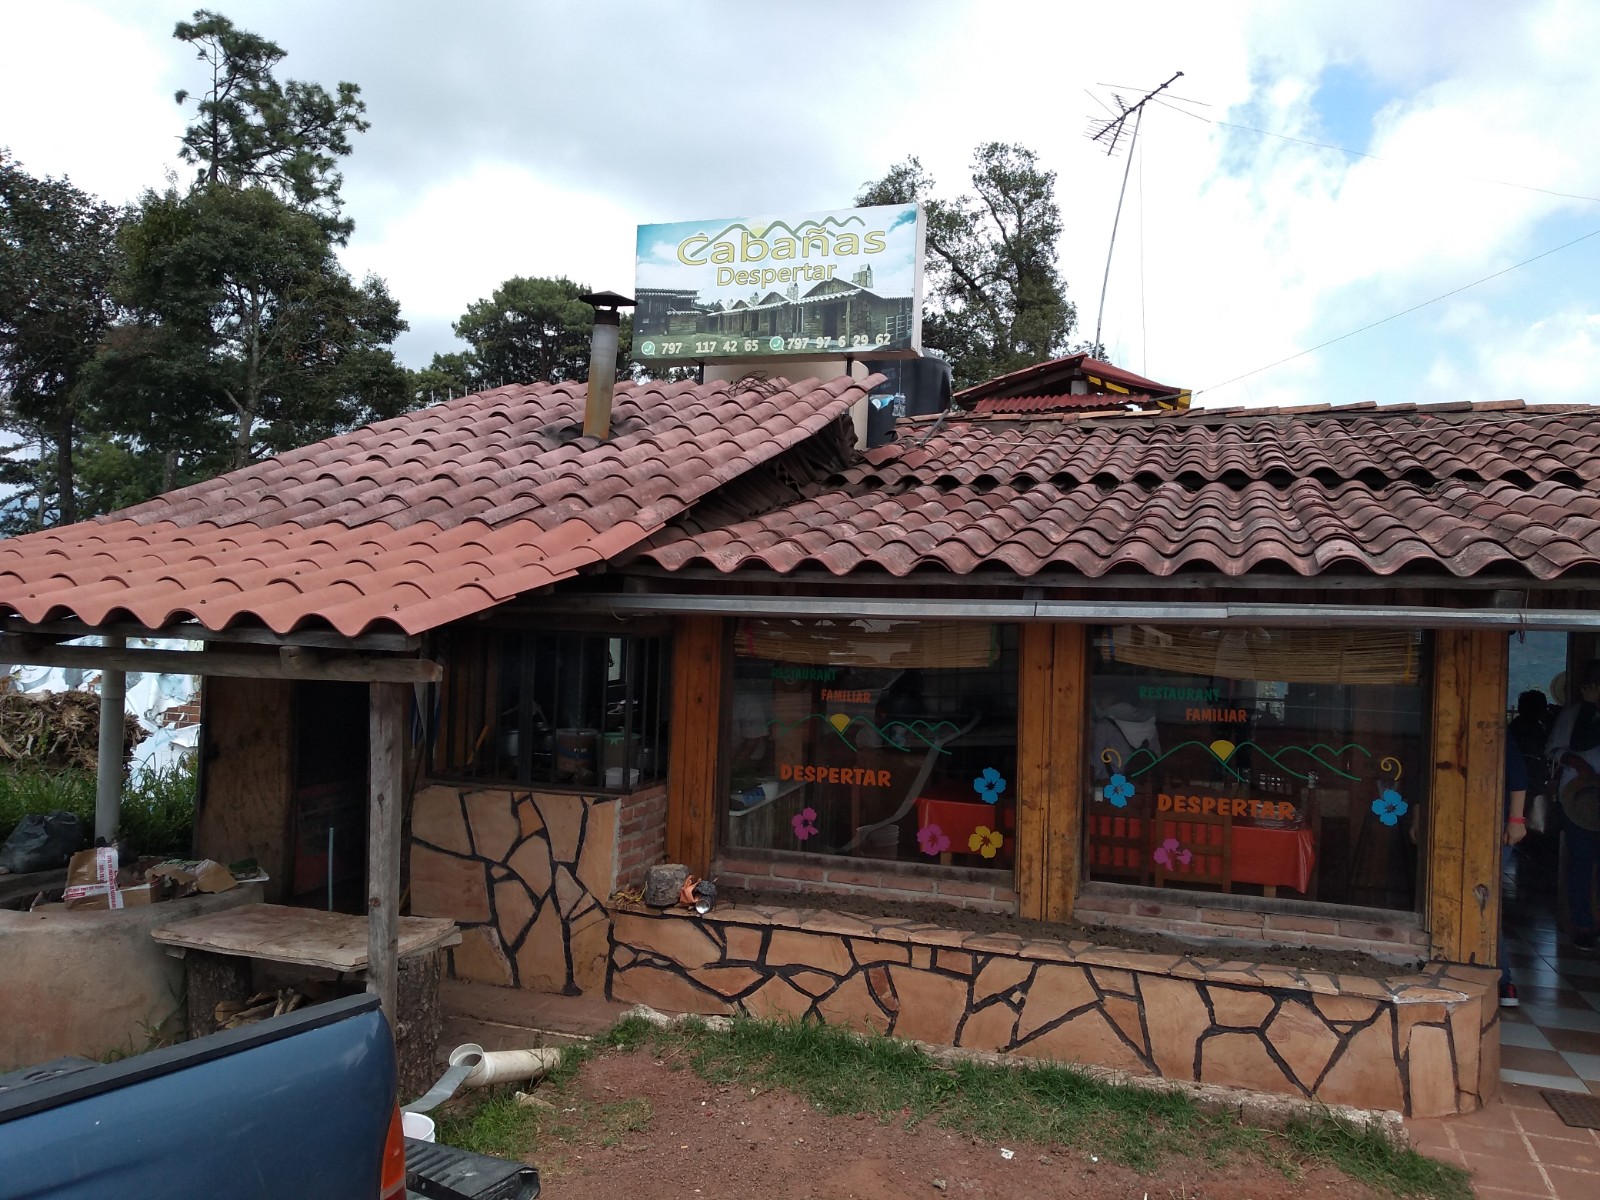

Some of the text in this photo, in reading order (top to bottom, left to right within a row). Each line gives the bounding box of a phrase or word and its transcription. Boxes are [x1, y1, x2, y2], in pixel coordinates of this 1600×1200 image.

[677, 226, 886, 266] Cabañas
[716, 263, 837, 289] Despertar
[661, 340, 759, 355] 797 117 42 65
[787, 333, 891, 350] 797 97 6 29 62
[771, 667, 838, 682] RESTAURANT
[821, 688, 872, 703] FAMILIAR
[1139, 685, 1221, 702] RESTAURANT
[1185, 708, 1247, 723] FAMILIAR
[779, 764, 892, 787] DESPERTAR
[1157, 793, 1295, 820] DESPERTAR
